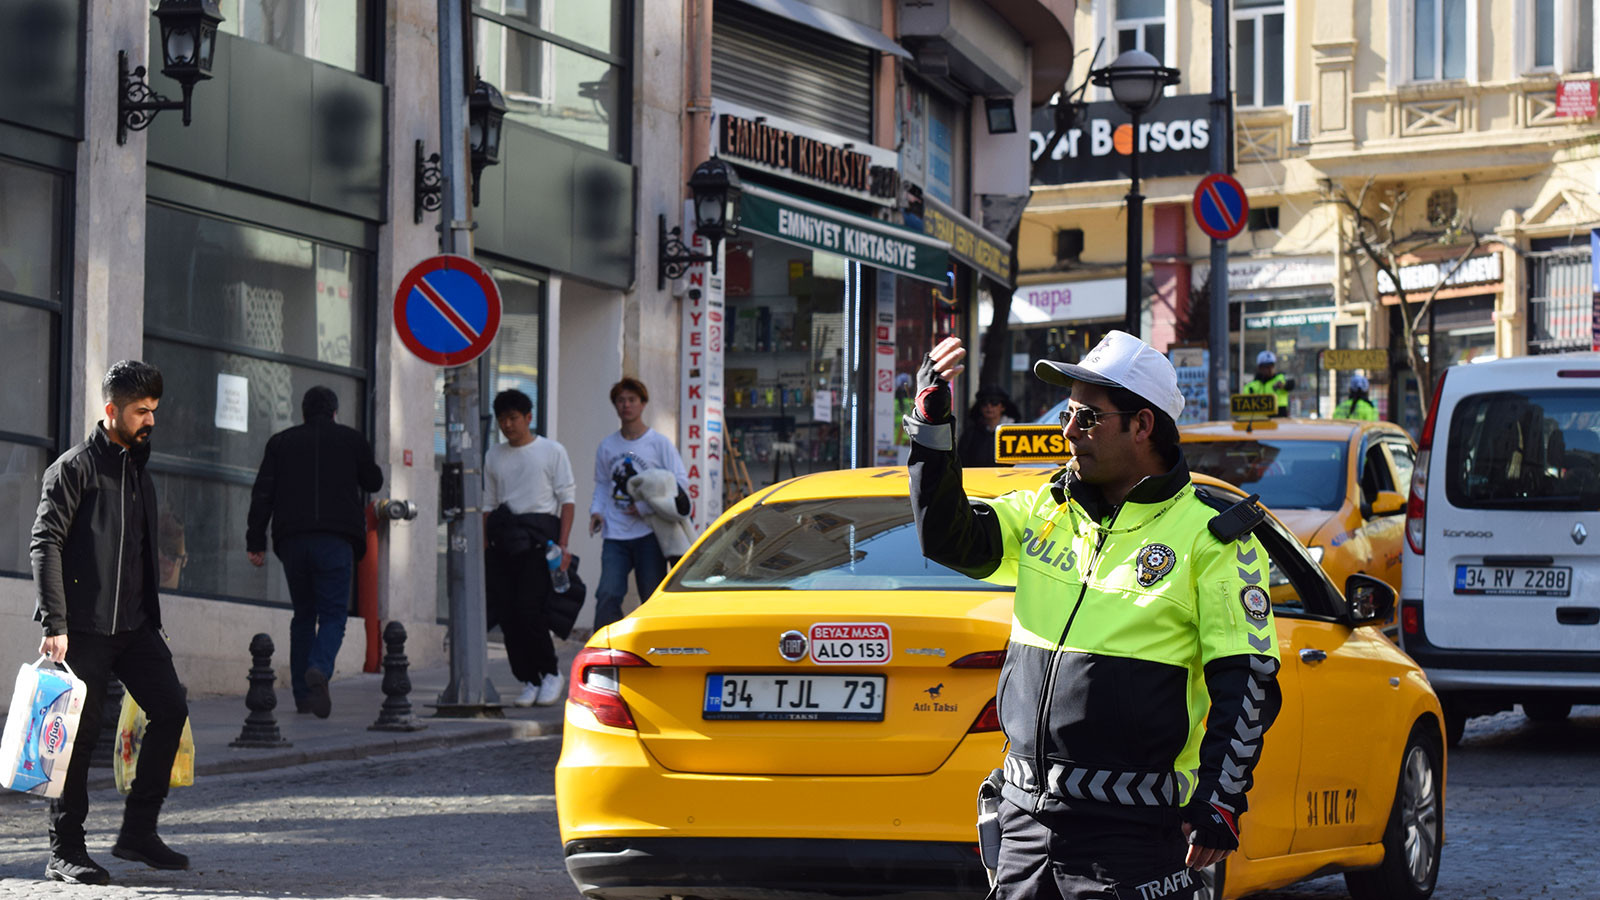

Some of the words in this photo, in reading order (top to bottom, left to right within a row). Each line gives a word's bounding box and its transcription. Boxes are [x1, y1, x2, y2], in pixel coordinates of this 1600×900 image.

[1028, 288, 1072, 315] napa
[1467, 569, 1485, 587] 34
[1494, 569, 1514, 587] RV
[1525, 570, 1566, 588] 2288
[815, 627, 849, 638] BEYAZ
[852, 627, 885, 638] MASA
[785, 639, 802, 653] FIAT
[818, 643, 854, 658] ALO
[858, 643, 885, 658] 153
[709, 696, 721, 705] TR
[723, 680, 753, 708] 34
[775, 680, 819, 708] TJL
[843, 681, 876, 709] 73
[933, 703, 958, 712] Taksi
[47, 716, 63, 754] Confort
[1307, 790, 1318, 827] 34
[1323, 790, 1341, 825] TJL
[1345, 788, 1357, 824] 73
